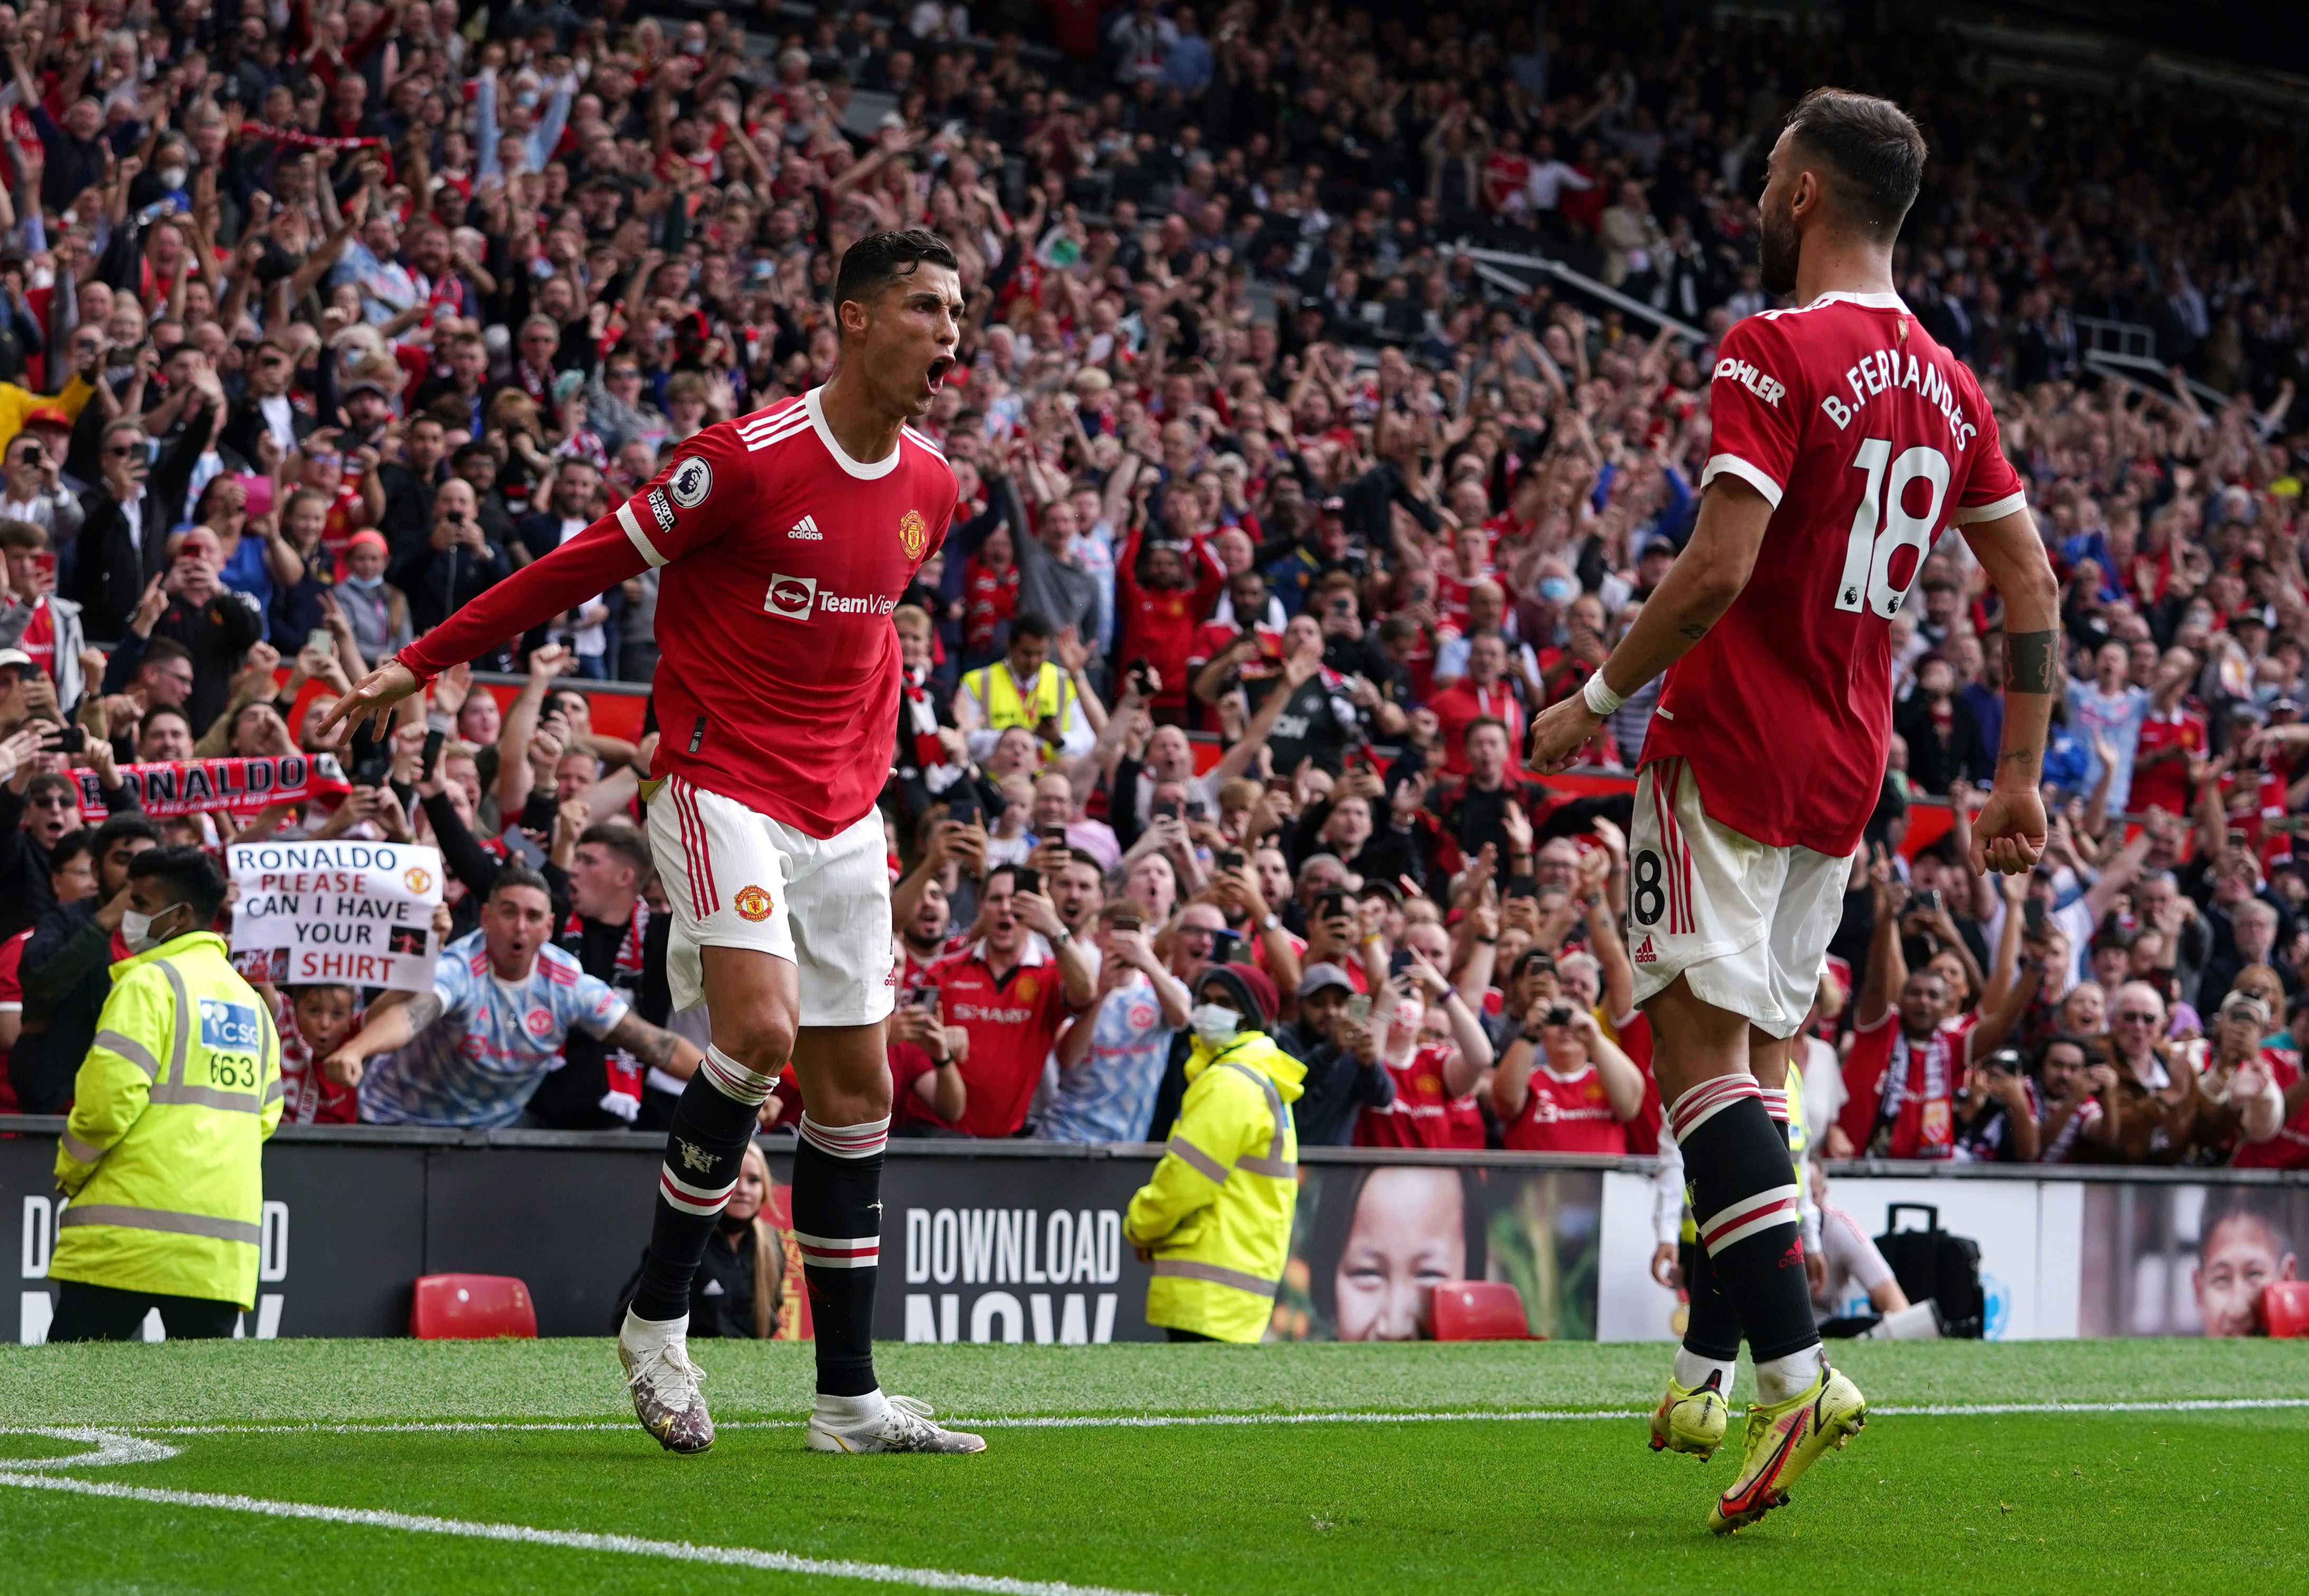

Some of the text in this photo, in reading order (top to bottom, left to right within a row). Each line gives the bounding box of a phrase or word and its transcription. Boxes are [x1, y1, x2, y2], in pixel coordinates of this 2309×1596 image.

[1821, 349, 1976, 452] B.FERNANDES
[675, 492, 700, 502] Premier League
[651, 504, 671, 533] racism
[660, 500, 675, 524] room
[788, 530, 823, 540] adidas
[1834, 438, 1951, 620] 18
[237, 847, 396, 870] RONALDO
[261, 873, 367, 895] PLEASE
[737, 888, 769, 901] MANCHESTER
[247, 895, 410, 921] CAN I HAVE
[296, 923, 372, 944] YOUR
[301, 953, 396, 982] SHIRT
[211, 1053, 255, 1087] 663
[905, 1208, 1121, 1285] DOWNLOAD
